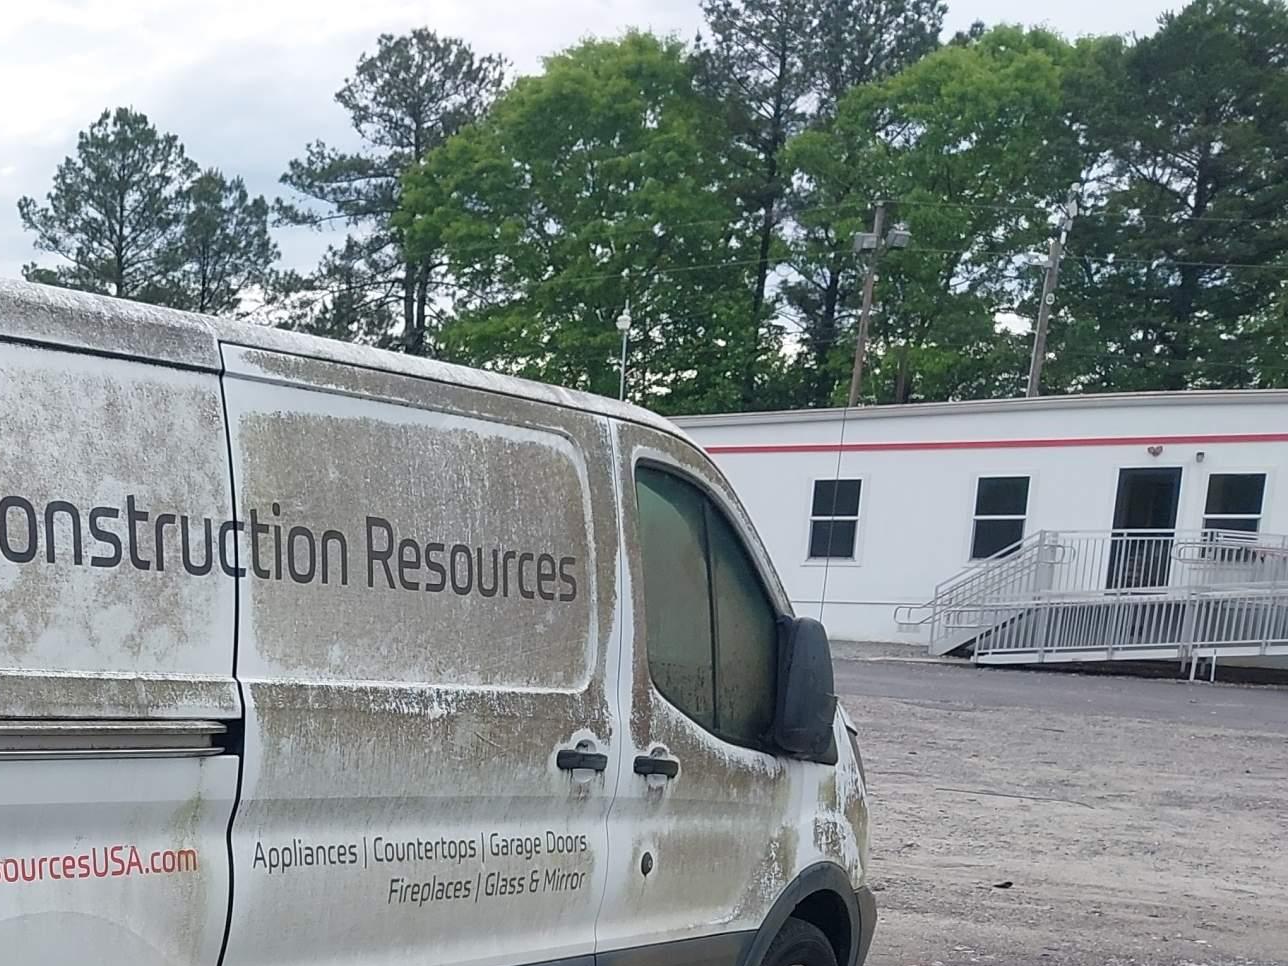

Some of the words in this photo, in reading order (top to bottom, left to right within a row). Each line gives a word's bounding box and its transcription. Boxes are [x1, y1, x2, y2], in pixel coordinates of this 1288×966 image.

[366, 516, 577, 602] Resources
[252, 839, 358, 874] Appliances
[373, 836, 476, 864] Countertops
[489, 832, 542, 859] Garage
[546, 831, 587, 854] Doors
[388, 875, 472, 907] Fireplaces
[484, 872, 525, 898] Glass
[528, 869, 539, 893] &
[542, 867, 586, 893] Mirror
